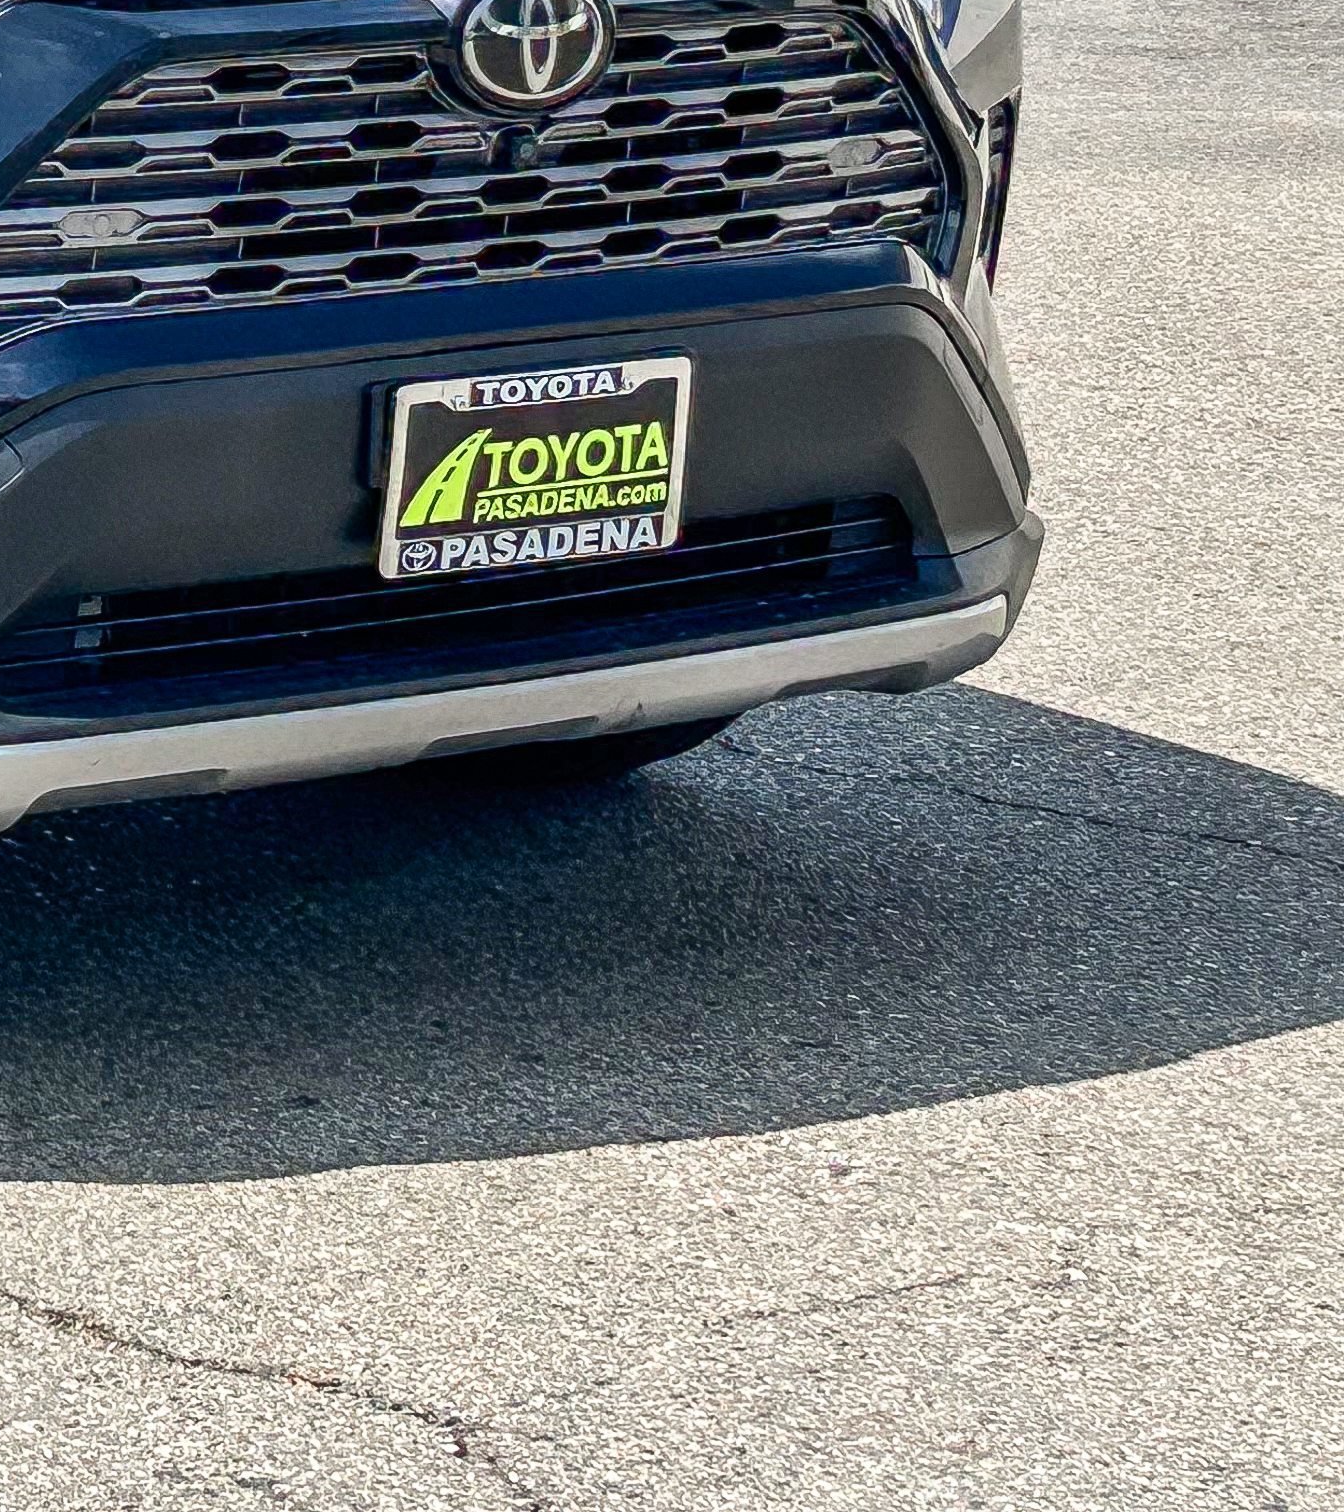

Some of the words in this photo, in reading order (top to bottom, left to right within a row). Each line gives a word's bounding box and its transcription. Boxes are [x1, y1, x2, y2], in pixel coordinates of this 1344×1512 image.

[475, 370, 616, 405] TOYOTA
[483, 421, 668, 487] TOYOTA
[472, 481, 667, 524] PASADENA.com
[441, 517, 660, 569] PASADENA
